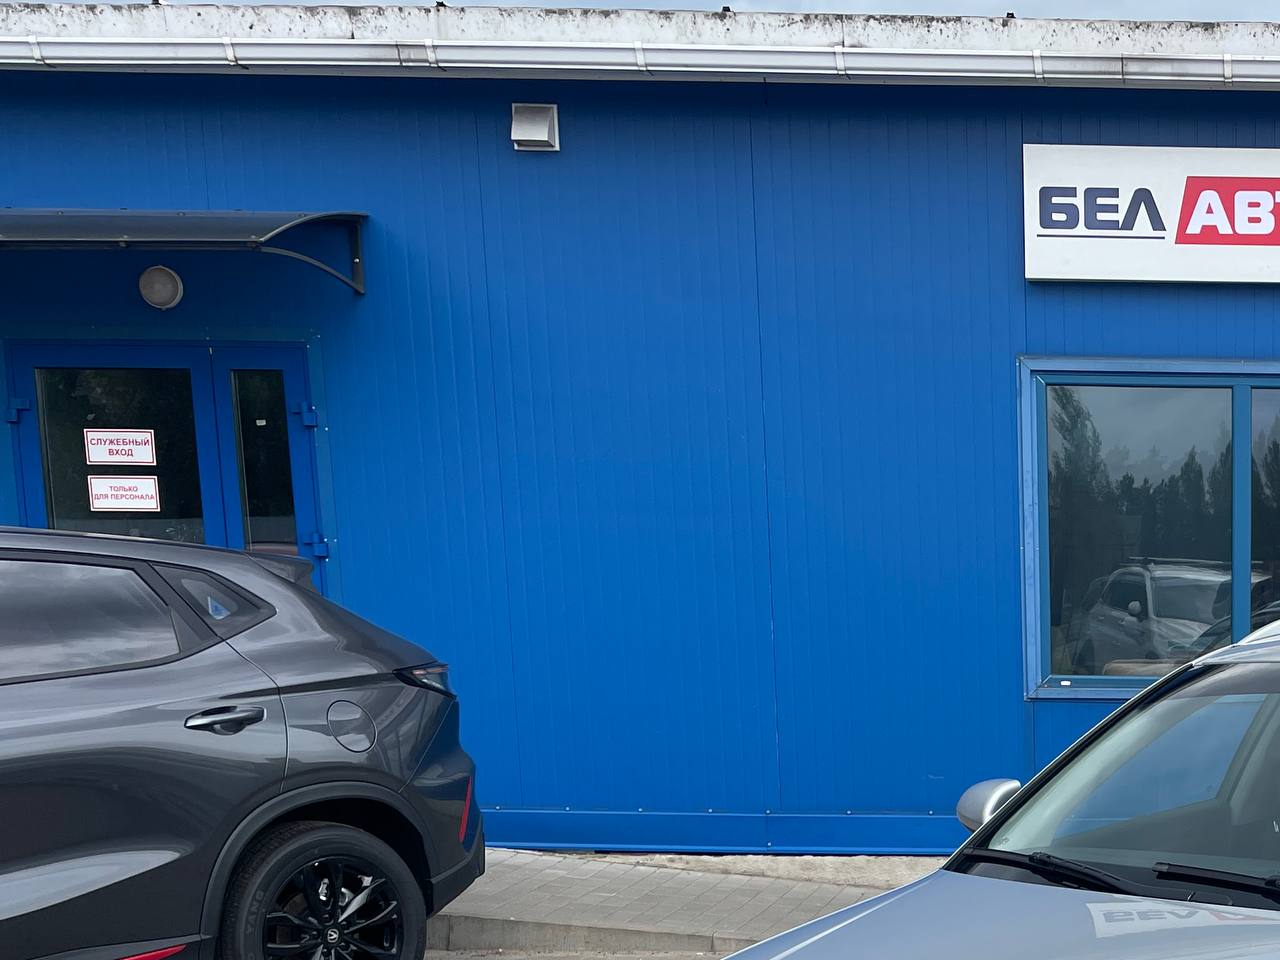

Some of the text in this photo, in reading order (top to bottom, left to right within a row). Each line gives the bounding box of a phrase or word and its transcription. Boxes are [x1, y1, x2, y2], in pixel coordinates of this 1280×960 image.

[1038, 186, 1165, 232] БЕЛ
[89, 436, 150, 446] СЛУЖЕБНЫЙ
[108, 448, 134, 457] ВХОД
